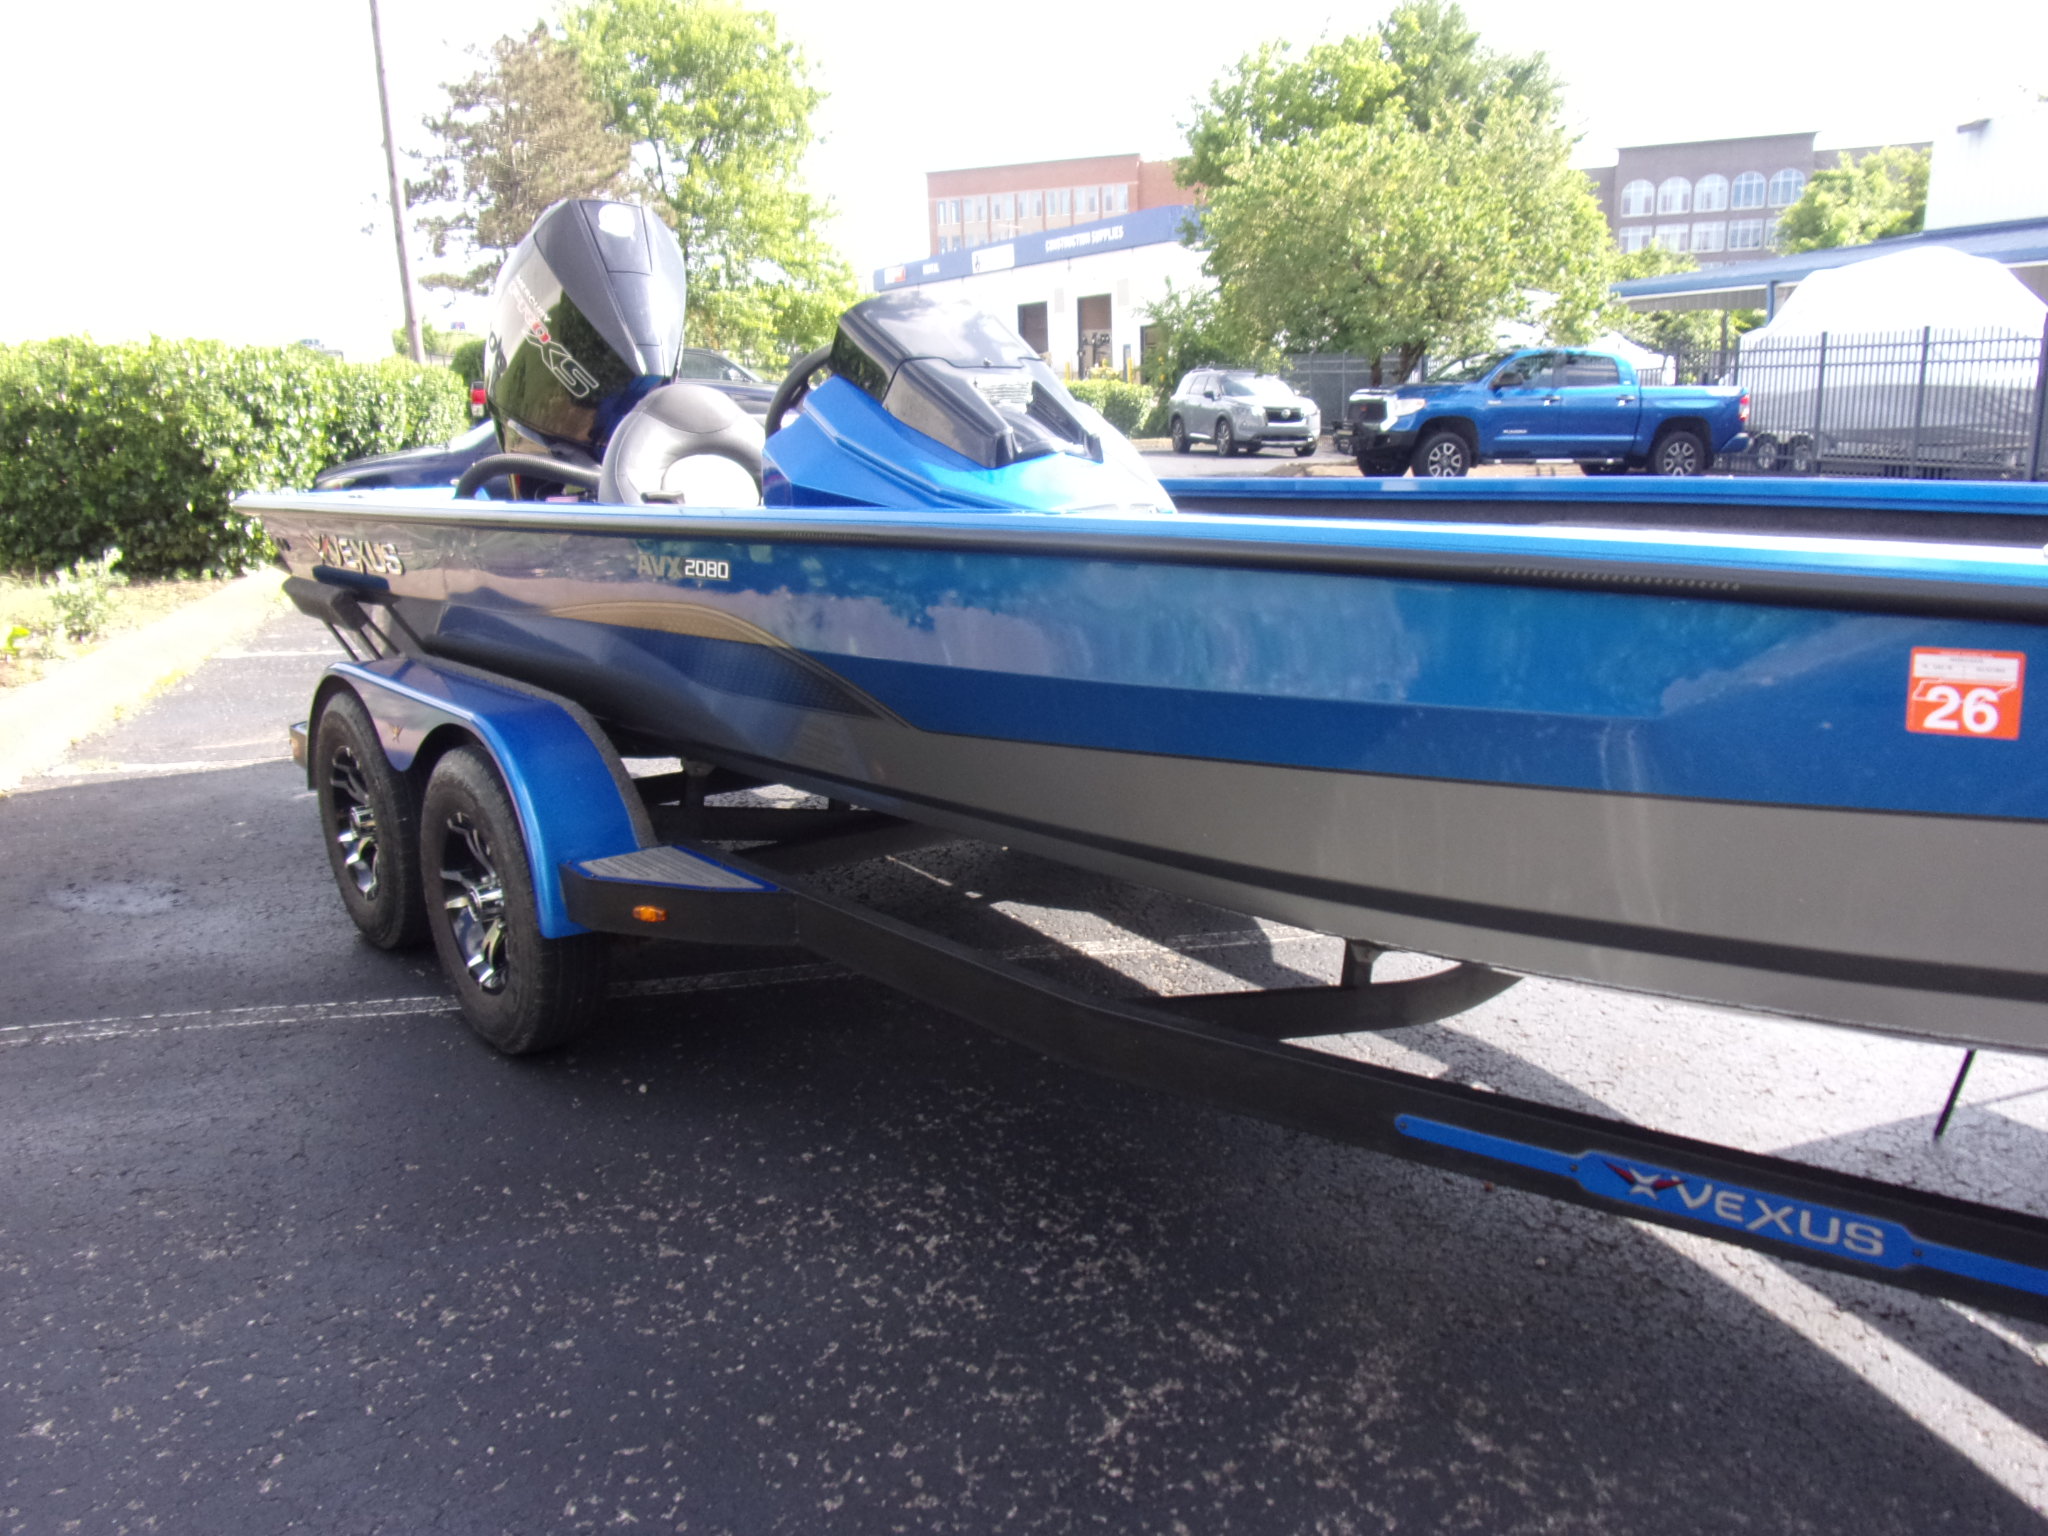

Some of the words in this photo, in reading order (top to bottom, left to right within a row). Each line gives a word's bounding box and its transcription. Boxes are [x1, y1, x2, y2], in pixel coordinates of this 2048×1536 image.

[637, 552, 683, 579] AVX
[684, 558, 730, 580] 2080
[1922, 684, 2000, 734] 26
[1671, 1175, 1885, 1257] VEXUS
